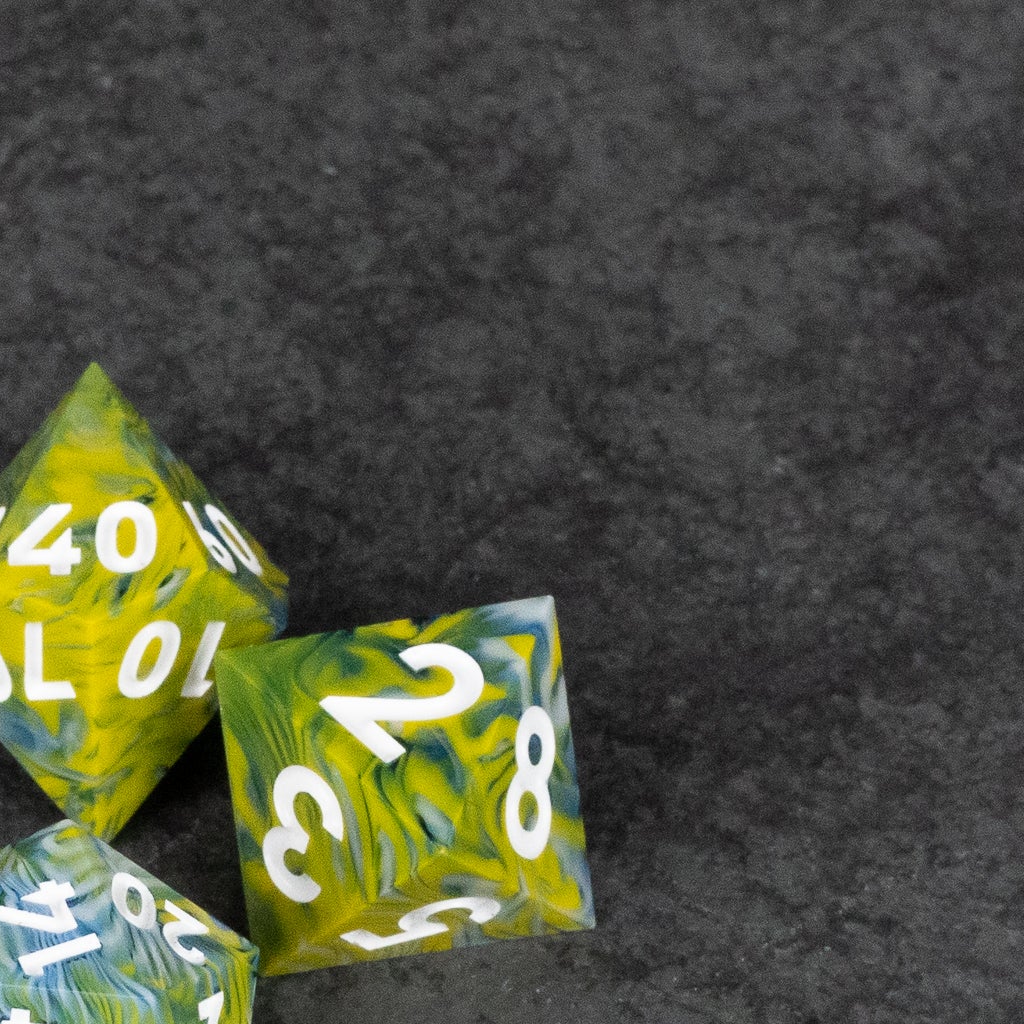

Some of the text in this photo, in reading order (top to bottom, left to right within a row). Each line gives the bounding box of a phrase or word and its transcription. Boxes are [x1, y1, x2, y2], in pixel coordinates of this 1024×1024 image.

[8, 501, 157, 575] 40
[183, 501, 263, 576] 60
[319, 643, 485, 764] 2
[505, 705, 556, 860] 8
[262, 764, 343, 904] 3
[111, 873, 209, 966] 20
[339, 896, 501, 951] 5
